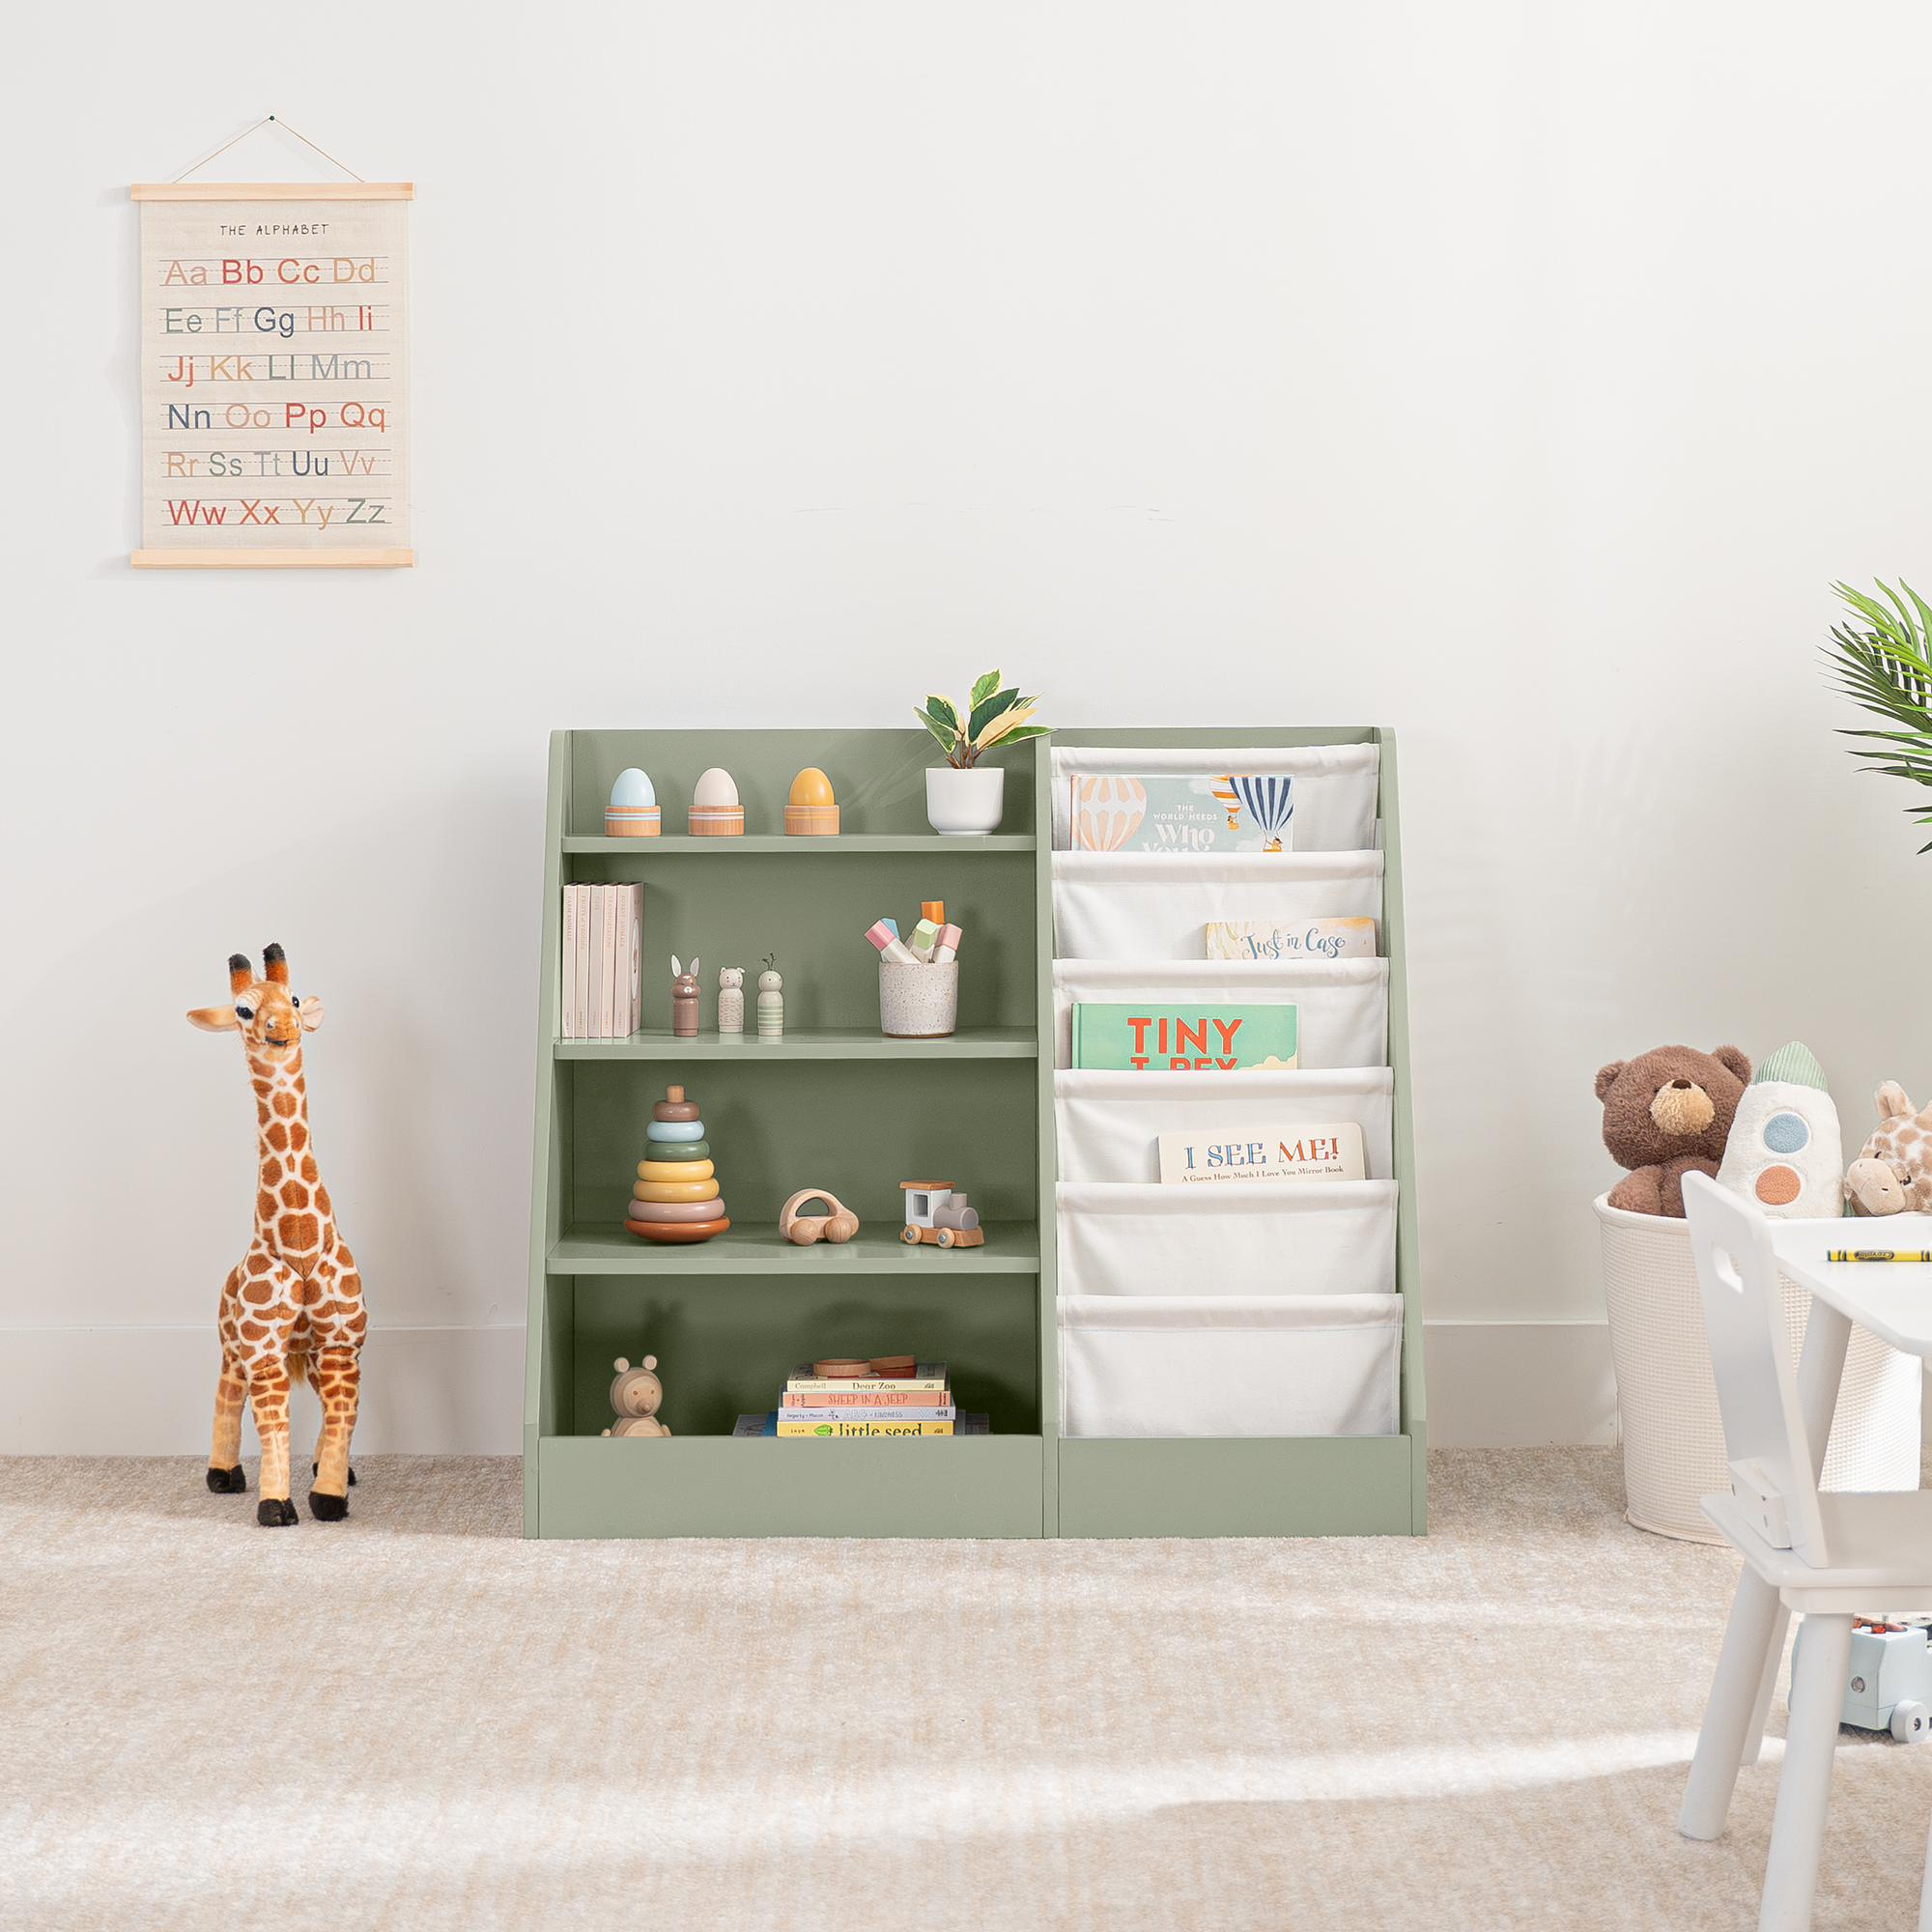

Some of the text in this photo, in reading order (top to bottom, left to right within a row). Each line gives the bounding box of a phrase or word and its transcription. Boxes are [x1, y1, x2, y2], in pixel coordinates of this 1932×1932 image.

[220, 224, 329, 236] THE ALPHABET
[164, 258, 375, 285] Aa Bb Cc Dd
[166, 306, 372, 338] Ee Ff Gg Hh Ii
[167, 355, 371, 387] Jj Kk Ll Mm
[169, 402, 385, 434] Nn Oo Pp Qq
[167, 450, 375, 477] Rr Ss Tt Uu Vv
[167, 498, 385, 530] Ww Xx Yy Zz
[1152, 812, 1218, 821] WORLD NEEDS
[1176, 805, 1194, 813] THE
[1154, 823, 1215, 852] Who
[1240, 927, 1346, 959] Just in Case
[1126, 1017, 1243, 1055] TINY
[1183, 1137, 1340, 1170] I SEE ME!
[1190, 1174, 1211, 1182] Guess
[828, 1393, 908, 1406] SHEEP IN A JEEP
[839, 1423, 880, 1436] little
[885, 1423, 922, 1436] seed
